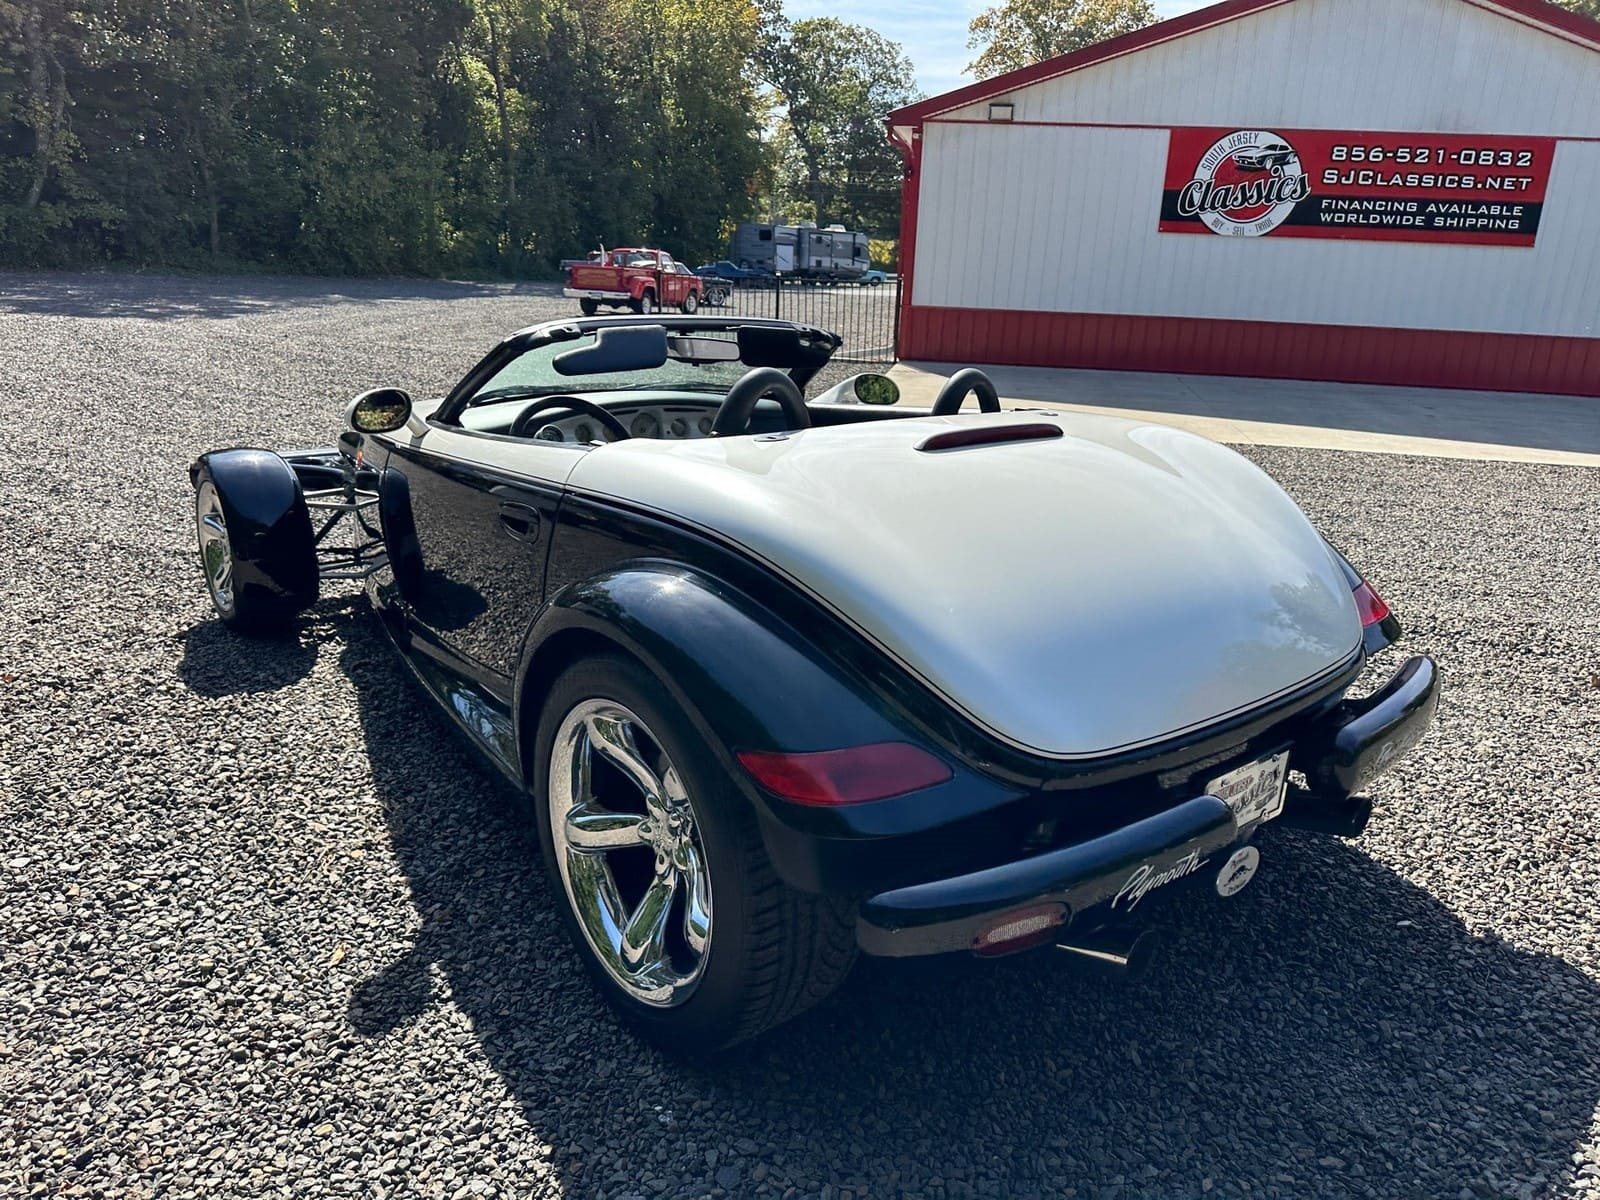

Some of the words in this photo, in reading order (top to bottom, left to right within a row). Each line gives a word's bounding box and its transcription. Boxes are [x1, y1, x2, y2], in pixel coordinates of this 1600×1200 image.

[1201, 143, 1226, 171] SOUTH
[1228, 132, 1260, 150] JERSEY
[1331, 146, 1532, 166] 856-521-0832
[1177, 173, 1311, 216] Classics
[1321, 199, 1418, 212] FINANCING
[1425, 202, 1524, 216] AVAILABLE
[1211, 217, 1226, 231] BUY
[1254, 217, 1274, 233] TRADE
[1320, 212, 1426, 226] WORLDWIDE
[1433, 216, 1520, 229] SHIPPING
[1110, 847, 1210, 913] Plymouth
